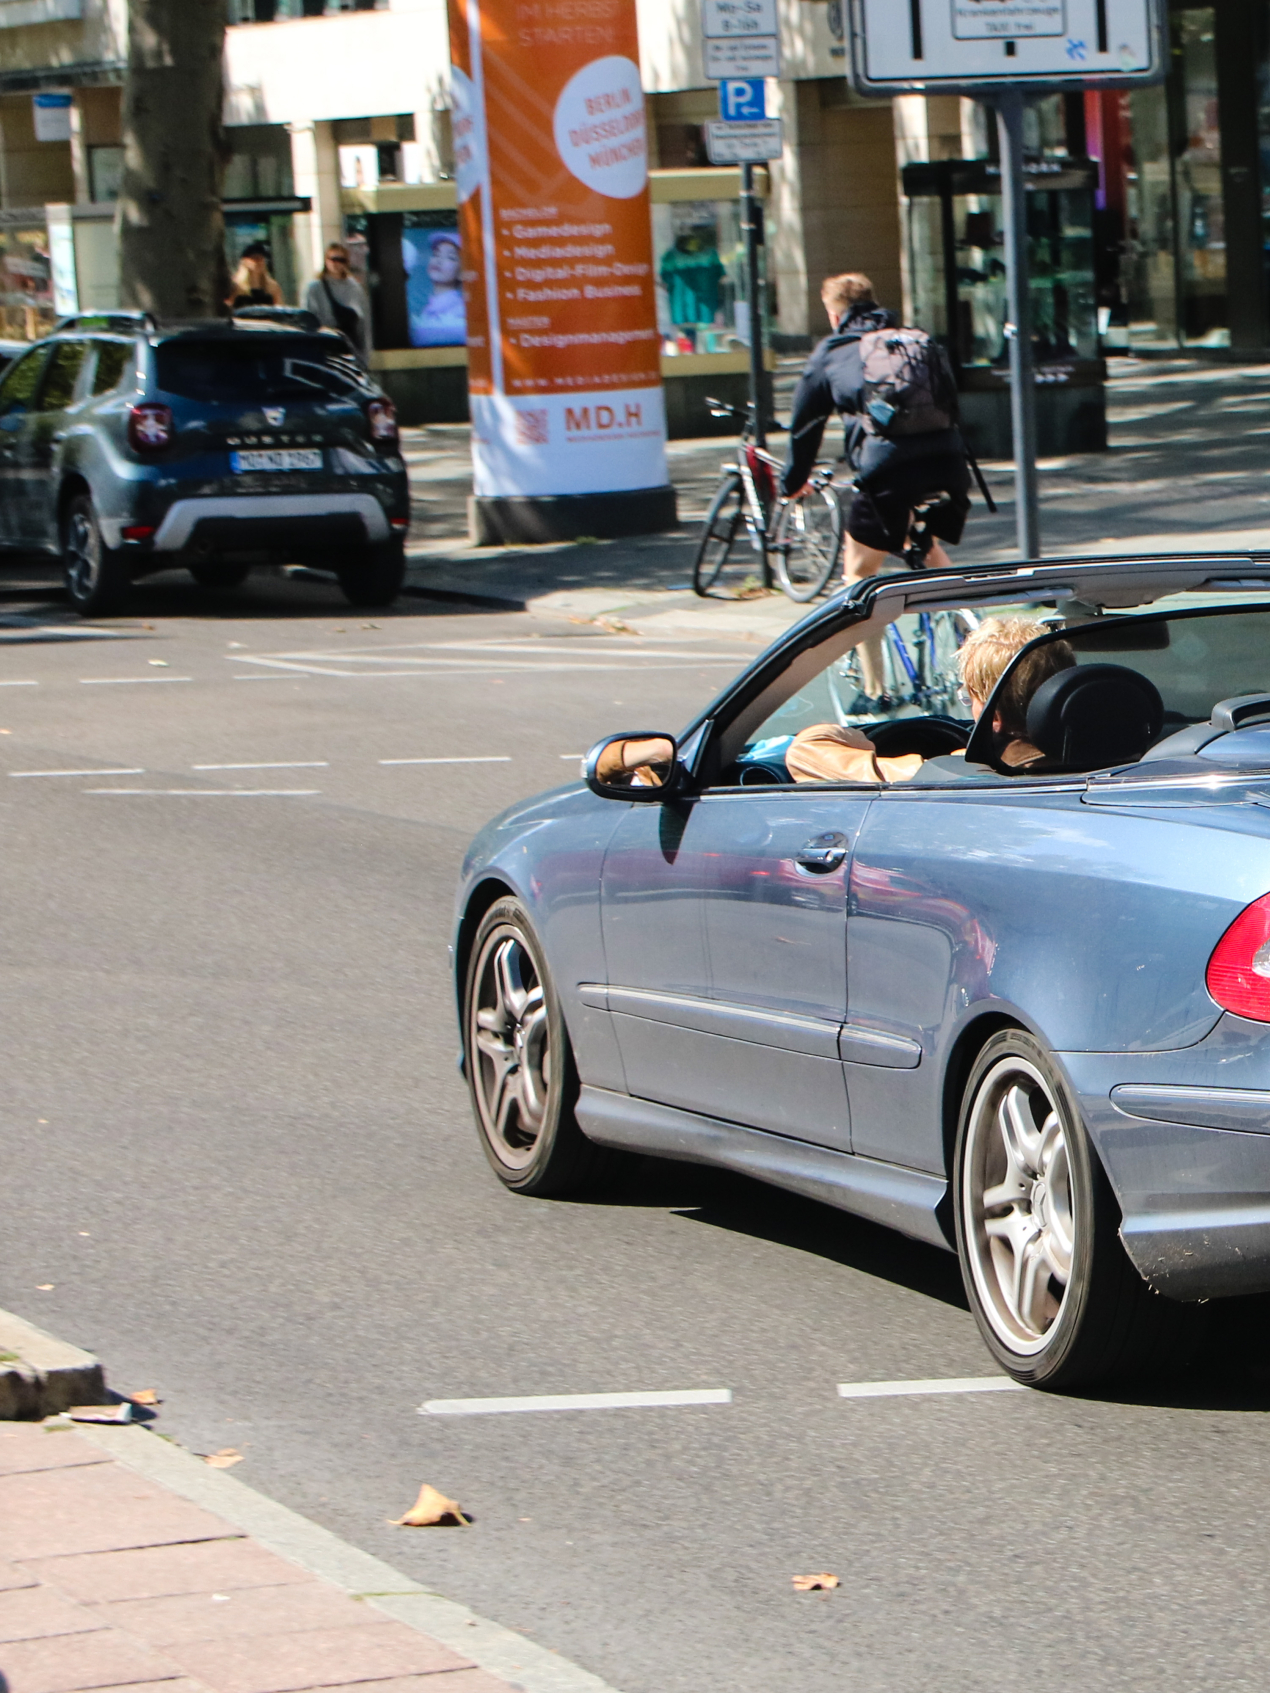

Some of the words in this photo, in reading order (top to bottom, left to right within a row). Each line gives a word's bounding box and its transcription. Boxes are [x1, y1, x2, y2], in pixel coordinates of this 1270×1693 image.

[584, 87, 632, 117] BERLIN
[727, 81, 754, 118] P
[512, 223, 613, 239] Gamedesign
[513, 244, 615, 260] Mediadesign
[516, 287, 581, 302] Fashion
[564, 402, 643, 433] MD.H
[226, 434, 324, 446] DUSTER
